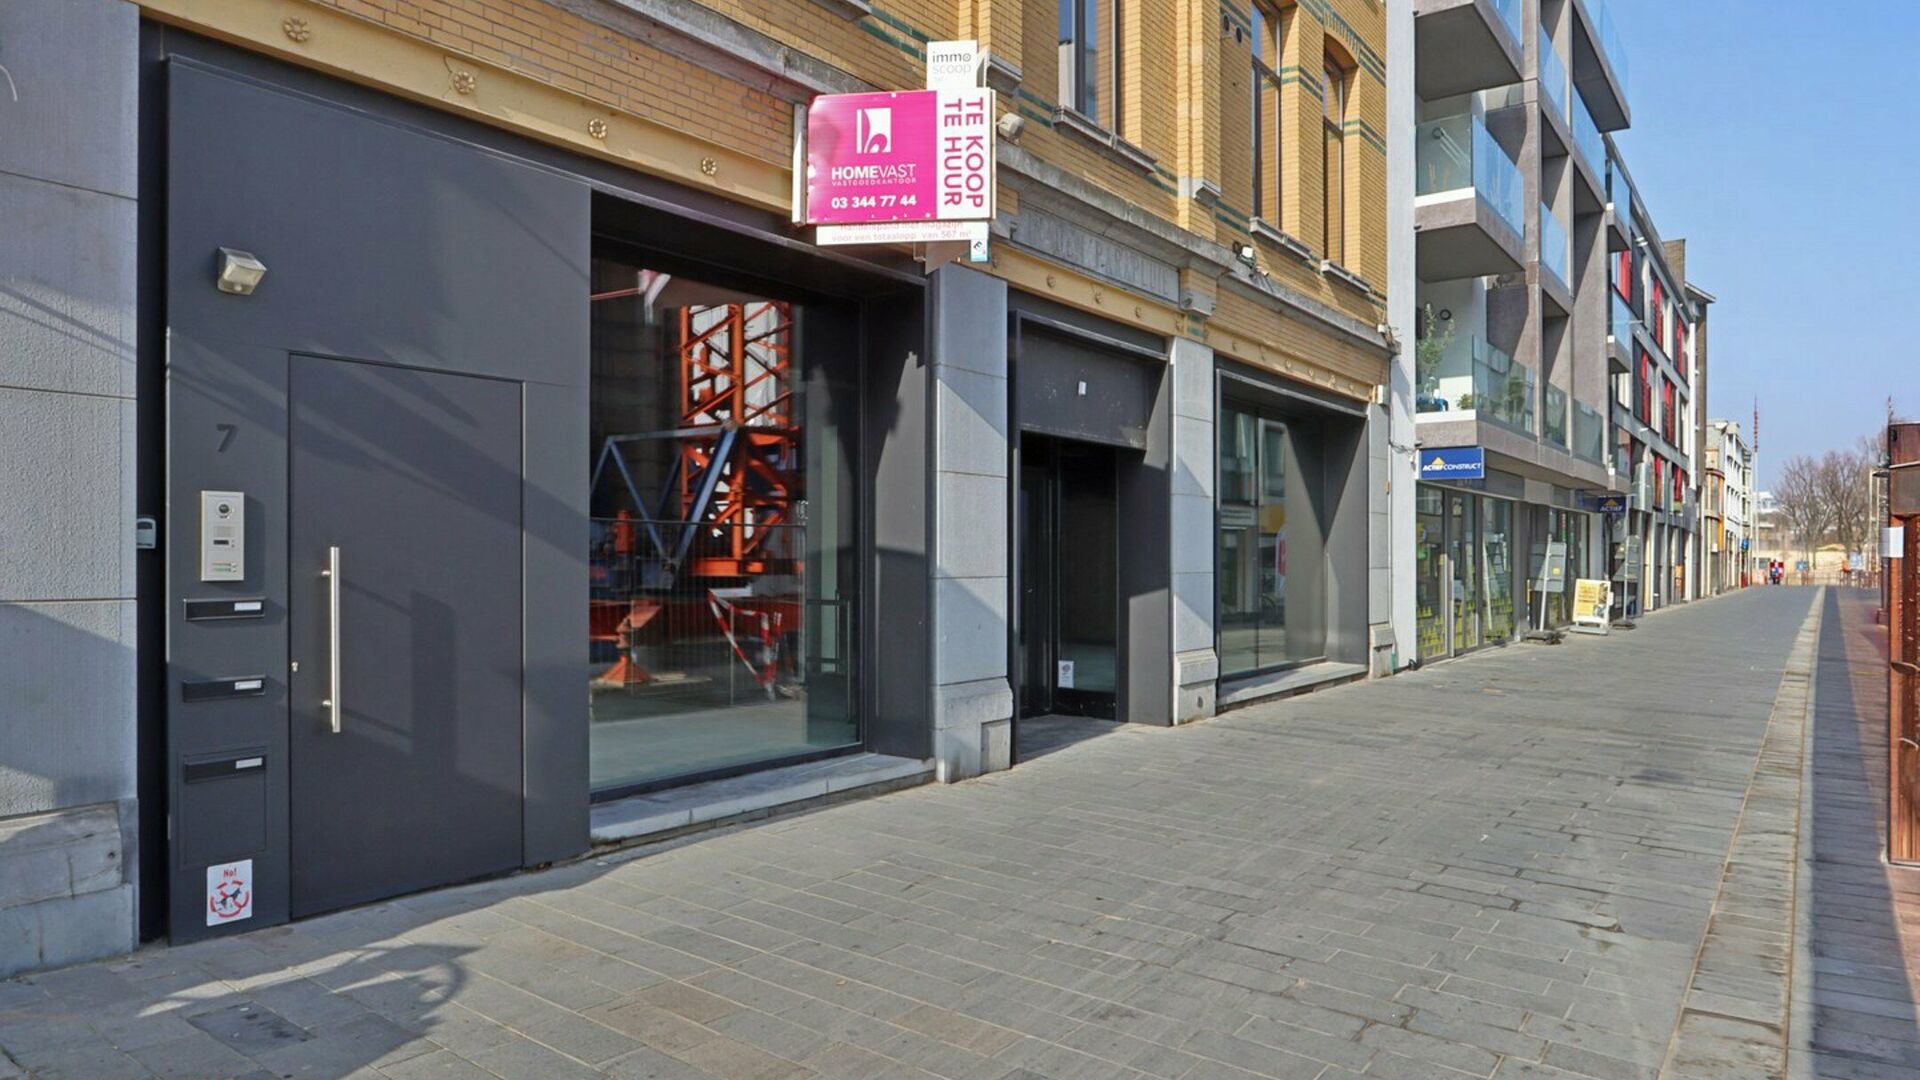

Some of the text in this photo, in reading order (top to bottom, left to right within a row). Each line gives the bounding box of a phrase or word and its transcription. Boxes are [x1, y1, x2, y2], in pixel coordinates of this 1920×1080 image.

[932, 51, 972, 63] immo
[932, 64, 972, 76] scoop
[944, 98, 962, 205] TE HUUR
[966, 97, 984, 208] TE KOOP
[831, 163, 916, 180] HOMEVAST
[831, 194, 917, 209] 03 344 77 44
[941, 230, 956, 239] 567
[216, 423, 239, 454] 7
[223, 868, 237, 878] No!
